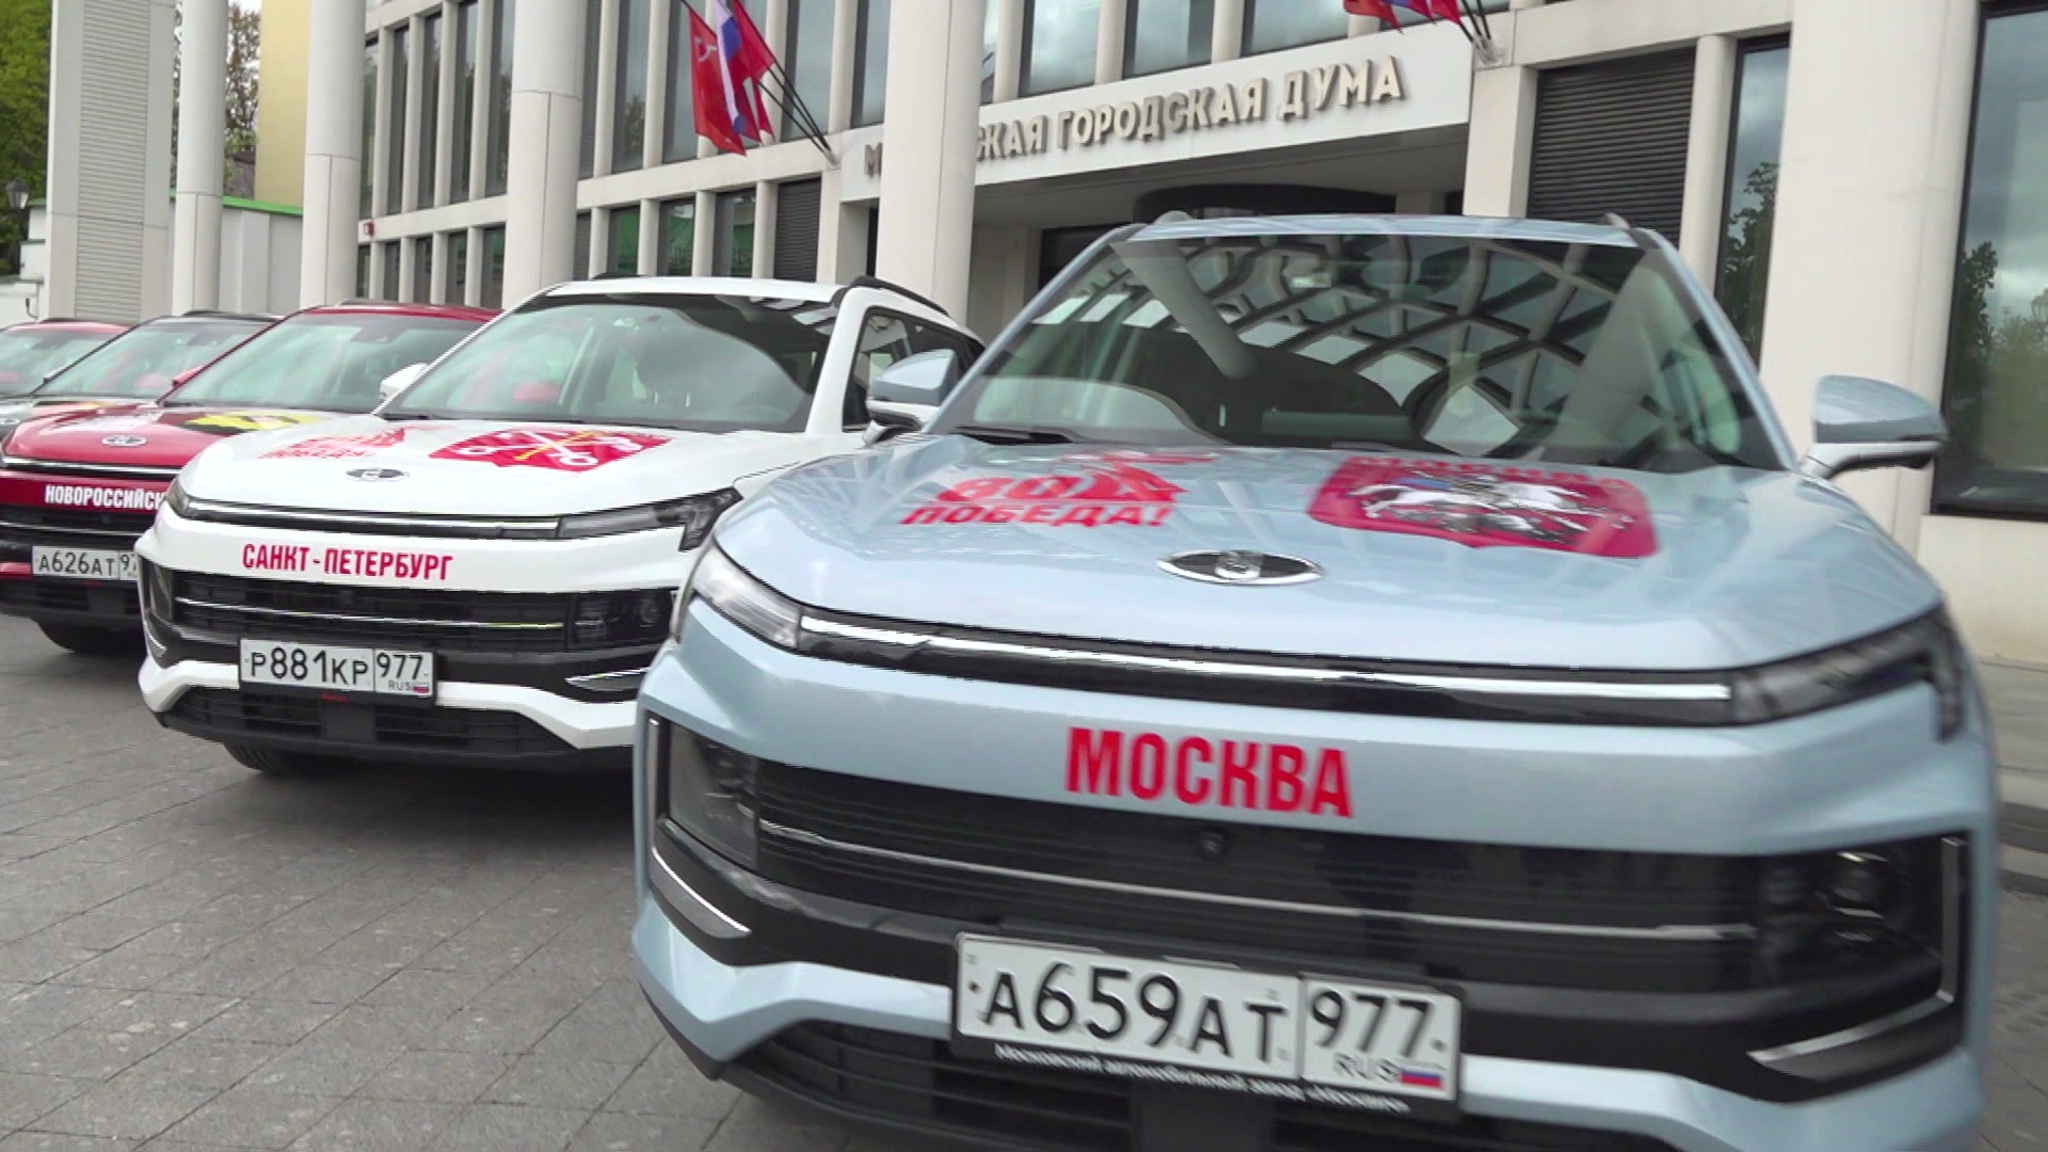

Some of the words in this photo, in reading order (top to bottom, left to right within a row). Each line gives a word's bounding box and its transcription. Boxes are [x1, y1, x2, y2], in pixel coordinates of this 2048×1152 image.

[1056, 77, 1267, 149] ГОРОДСКАЯ
[1279, 55, 1407, 120] ДУМА
[900, 505, 1173, 527] ПОБЕДА!
[38, 550, 116, 576] А626АТ
[250, 647, 369, 685] Р881КР
[375, 652, 424, 680] 977
[388, 679, 412, 692] RUS
[1066, 726, 1353, 820] МОСКВА
[982, 961, 1288, 1064] А659АТ
[1311, 989, 1435, 1059] 977
[1332, 1051, 1402, 1083] RUS
